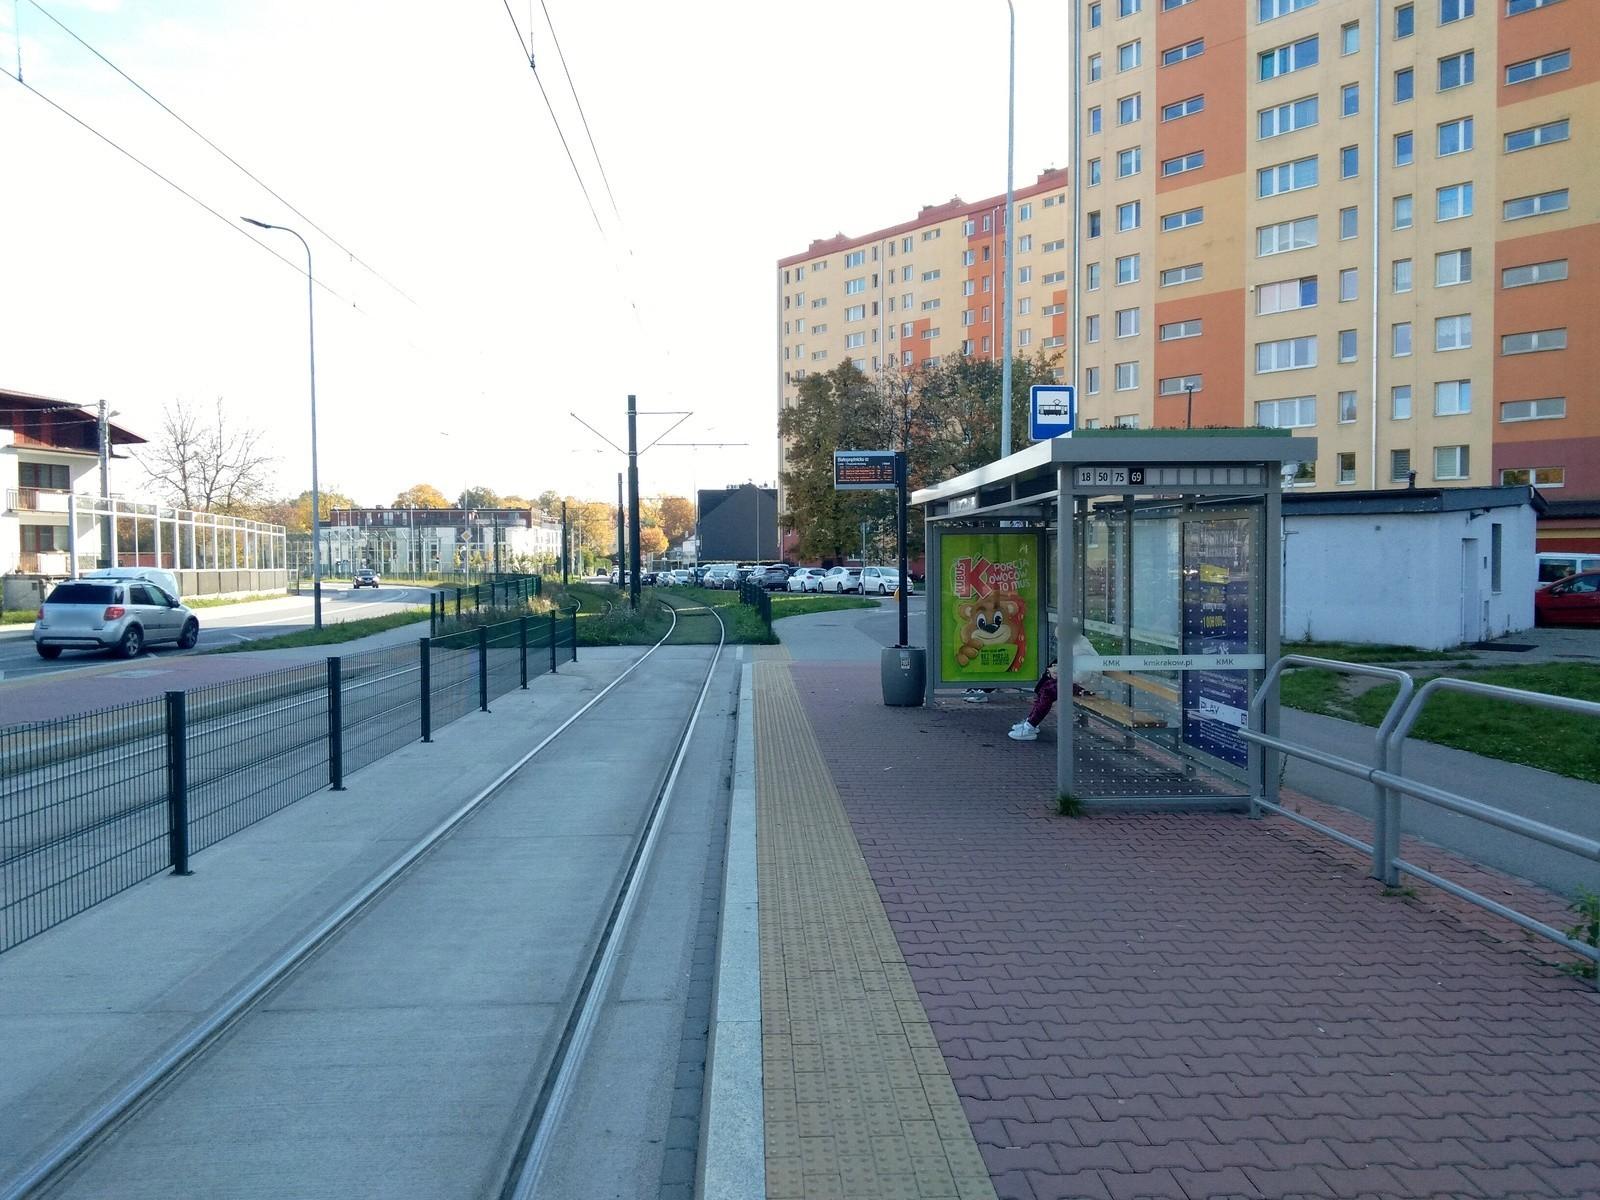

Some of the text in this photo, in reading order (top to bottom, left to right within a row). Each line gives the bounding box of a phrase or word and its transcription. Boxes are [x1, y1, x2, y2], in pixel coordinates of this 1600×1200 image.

[1081, 471, 1142, 482] 18 50 75 69
[954, 560, 966, 595] KUBUS
[997, 578, 1031, 592] TO MUS
[1102, 658, 1234, 668] KMK kmkrakow.pl KMK
